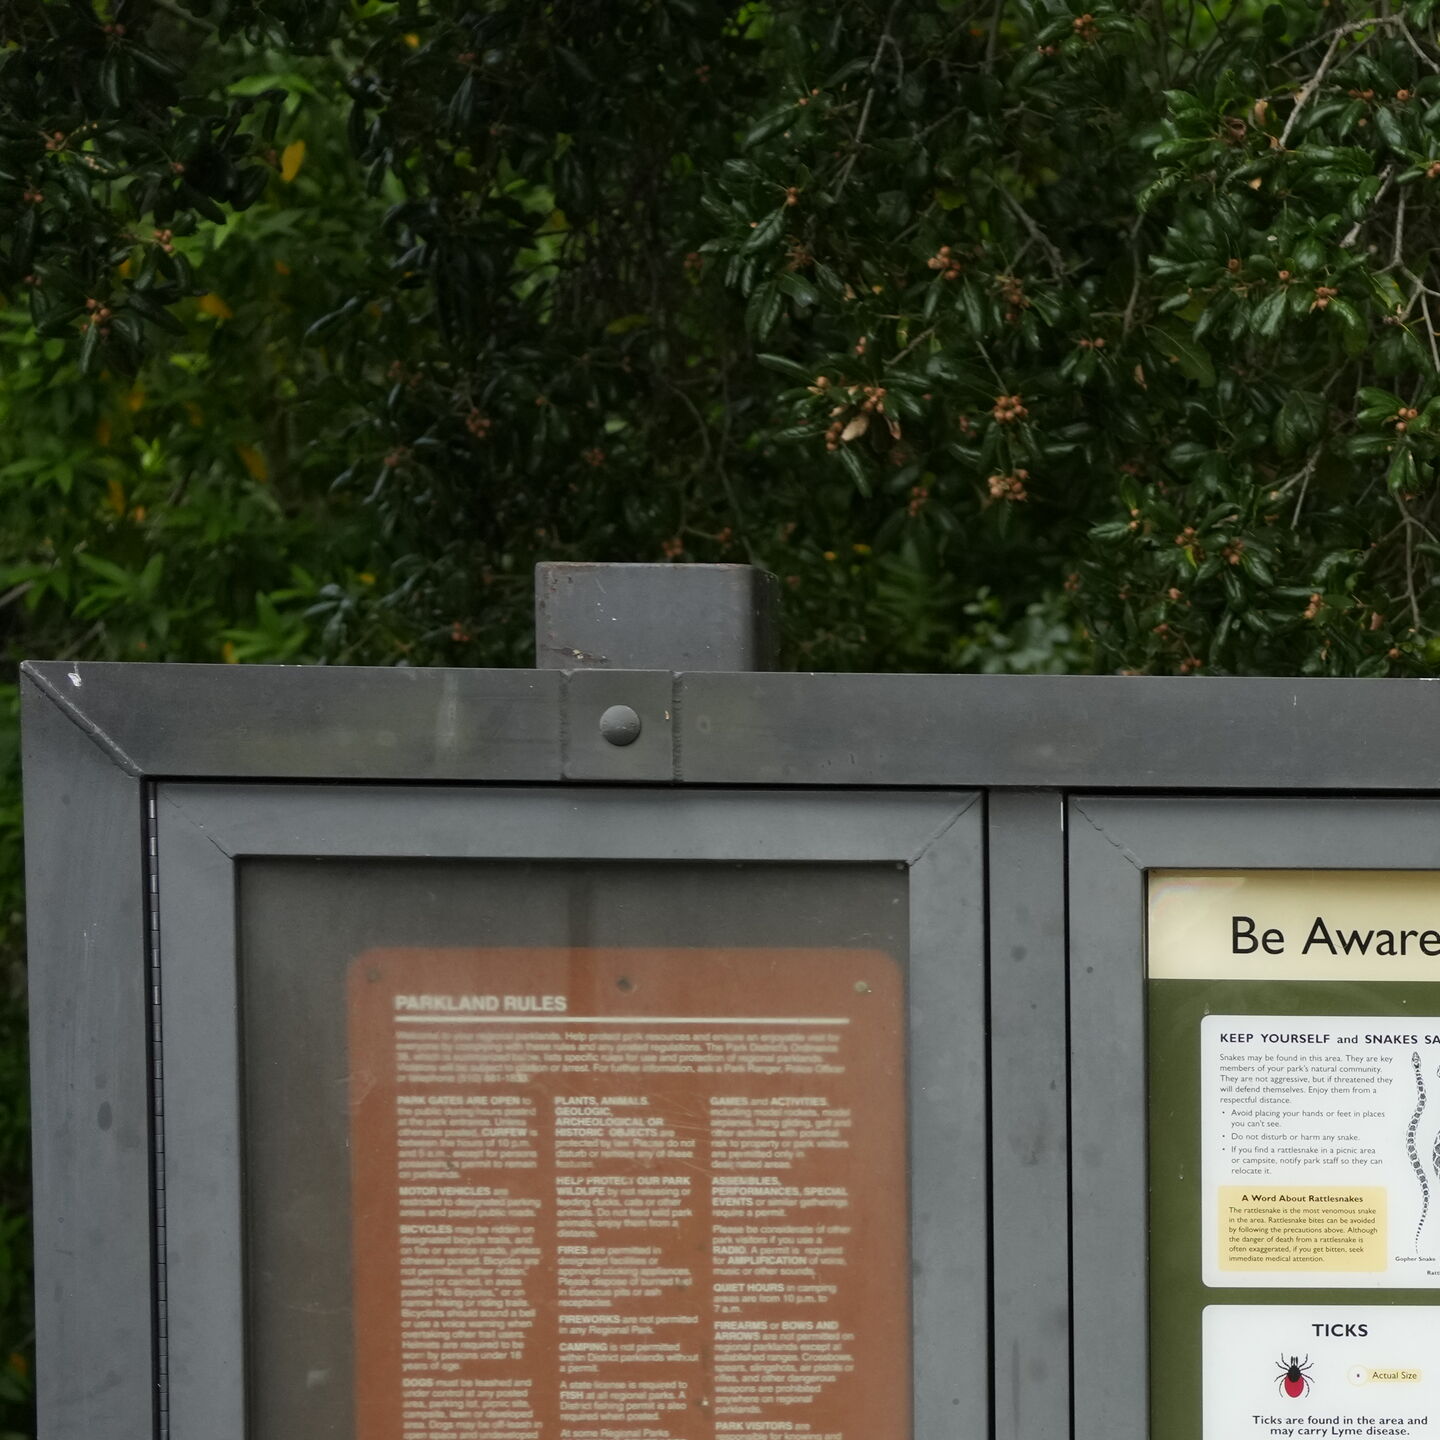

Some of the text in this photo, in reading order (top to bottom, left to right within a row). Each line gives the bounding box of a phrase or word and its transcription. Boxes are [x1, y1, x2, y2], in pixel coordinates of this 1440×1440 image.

[1231, 915, 1285, 955] Be
[395, 995, 567, 1012] PARKLAND RULES
[1220, 1033, 1254, 1043] KEEP
[1260, 1033, 1330, 1044] YOURSELF
[1336, 1034, 1359, 1044] and
[1364, 1034, 1418, 1045] SNAKES
[1311, 1323, 1369, 1338] TICKS
[1372, 1371, 1418, 1380] Actual Size
[1252, 1415, 1283, 1425] Ticks
[1285, 1417, 1305, 1425] are
[1307, 1415, 1340, 1425] found
[1343, 1415, 1354, 1425] in
[1356, 1415, 1376, 1425] the
[1407, 1415, 1428, 1425] and
[1270, 1425, 1410, 1438] may carry Lyme disease.
